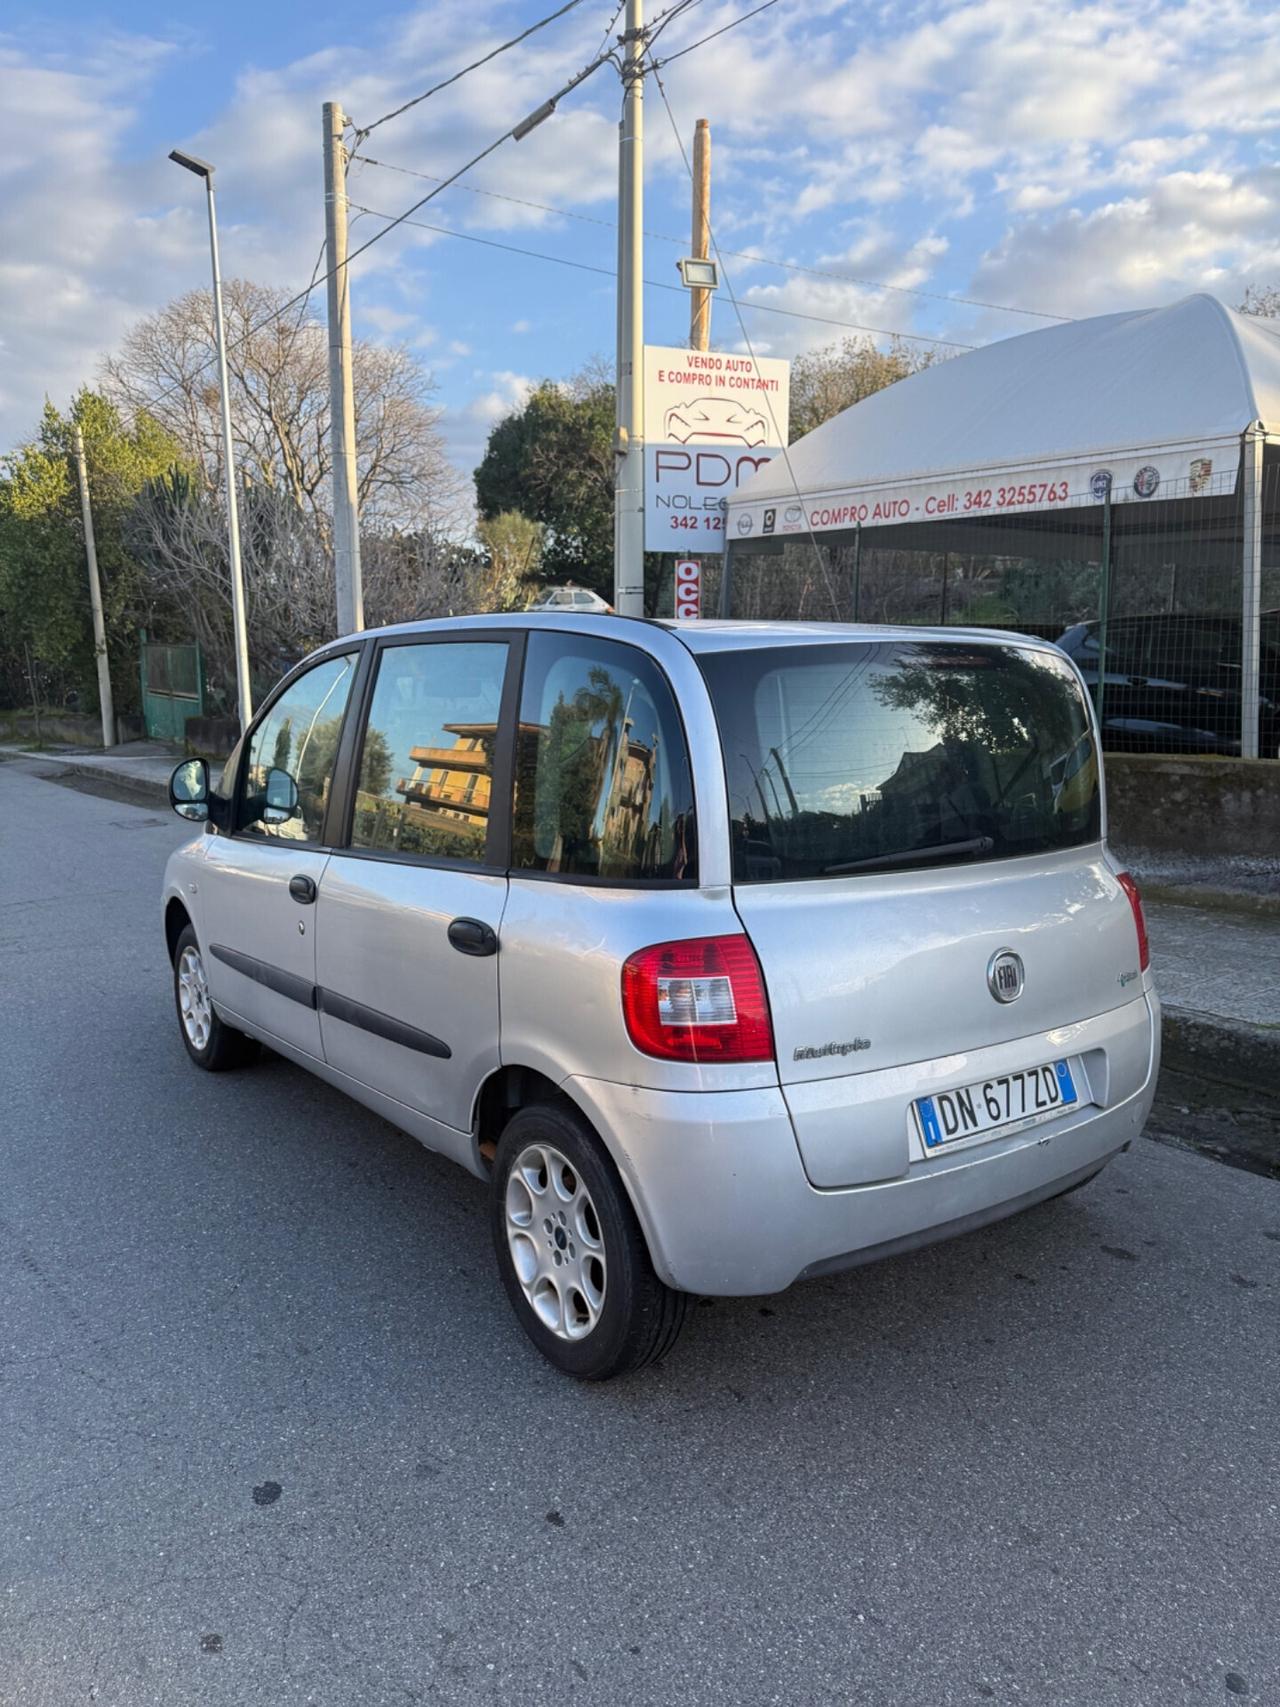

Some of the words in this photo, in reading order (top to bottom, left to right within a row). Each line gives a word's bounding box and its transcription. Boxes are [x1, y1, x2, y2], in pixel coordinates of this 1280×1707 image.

[687, 355, 722, 370] VENDO
[725, 359, 753, 373] AUTO
[658, 370, 665, 382] E
[668, 371, 712, 386] COMPRO
[715, 375, 726, 387] IN
[728, 376, 779, 391] CONTANTI
[810, 504, 868, 527] COMPRO
[872, 499, 910, 520] AUTO
[925, 493, 959, 514] Cell:
[963, 486, 992, 510] 342
[996, 481, 1069, 507] 3255763
[670, 515, 698, 530] 342
[937, 1088, 979, 1136] DN
[982, 1065, 1060, 1122] 677ZD
